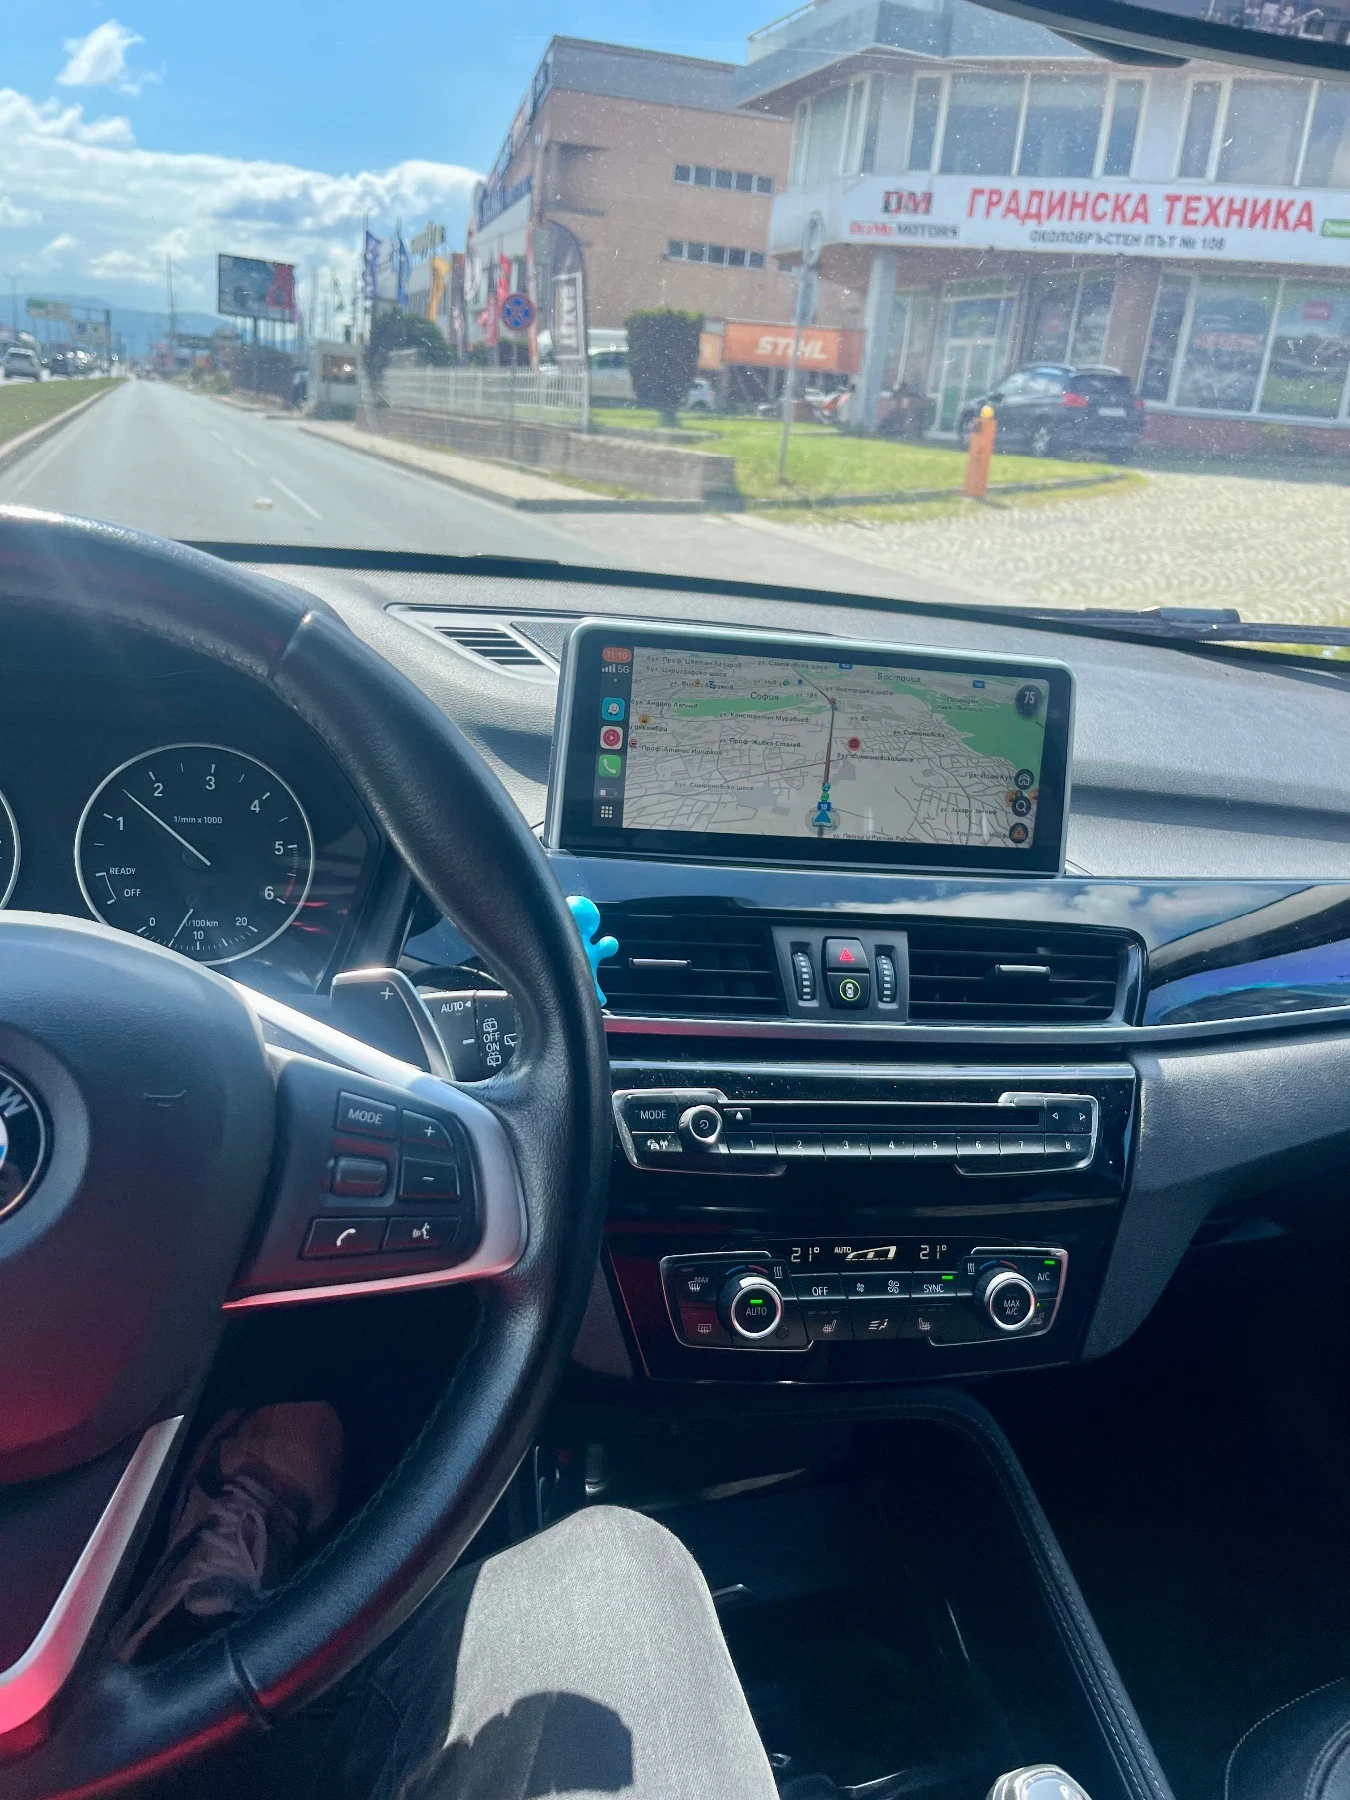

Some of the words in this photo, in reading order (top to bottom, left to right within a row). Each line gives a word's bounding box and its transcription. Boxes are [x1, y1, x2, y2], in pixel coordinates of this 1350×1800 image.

[967, 186, 1151, 227] ГРАДИНСКА
[1163, 193, 1315, 234] ТЕХНИКА
[1143, 232, 1177, 249] ПЪТ
[617, 665, 630, 674] 5G
[750, 691, 780, 701] София
[1024, 691, 1036, 704] 75
[205, 776, 216, 791] 3
[153, 783, 164, 798] 2
[250, 800, 261, 815] 4
[116, 816, 125, 831] 1
[204, 816, 223, 825] 1000
[274, 841, 284, 856] 5
[109, 867, 136, 876] READY
[123, 888, 142, 898] OFF
[264, 886, 275, 901] 6
[149, 917, 156, 927] 0
[235, 916, 248, 926] 20
[193, 932, 204, 942] 10
[440, 1001, 464, 1013] AUTO
[483, 1034, 500, 1042] OFF
[486, 1043, 499, 1051] ON
[348, 1109, 383, 1125] MODE
[640, 1110, 668, 1121] MODE
[843, 1140, 849, 1149] 3
[888, 1140, 895, 1149] 4
[932, 1140, 939, 1149] 5
[975, 1141, 981, 1150] 6
[1019, 1141, 1024, 1149] 7
[834, 1246, 852, 1254] AUTO
[1037, 1272, 1050, 1281] A/C
[812, 1286, 829, 1296] OFF
[923, 1284, 945, 1293] SYNC
[1003, 1300, 1020, 1308] MAX
[746, 1307, 767, 1316] AUTO
[1006, 1308, 1018, 1316] A/C
